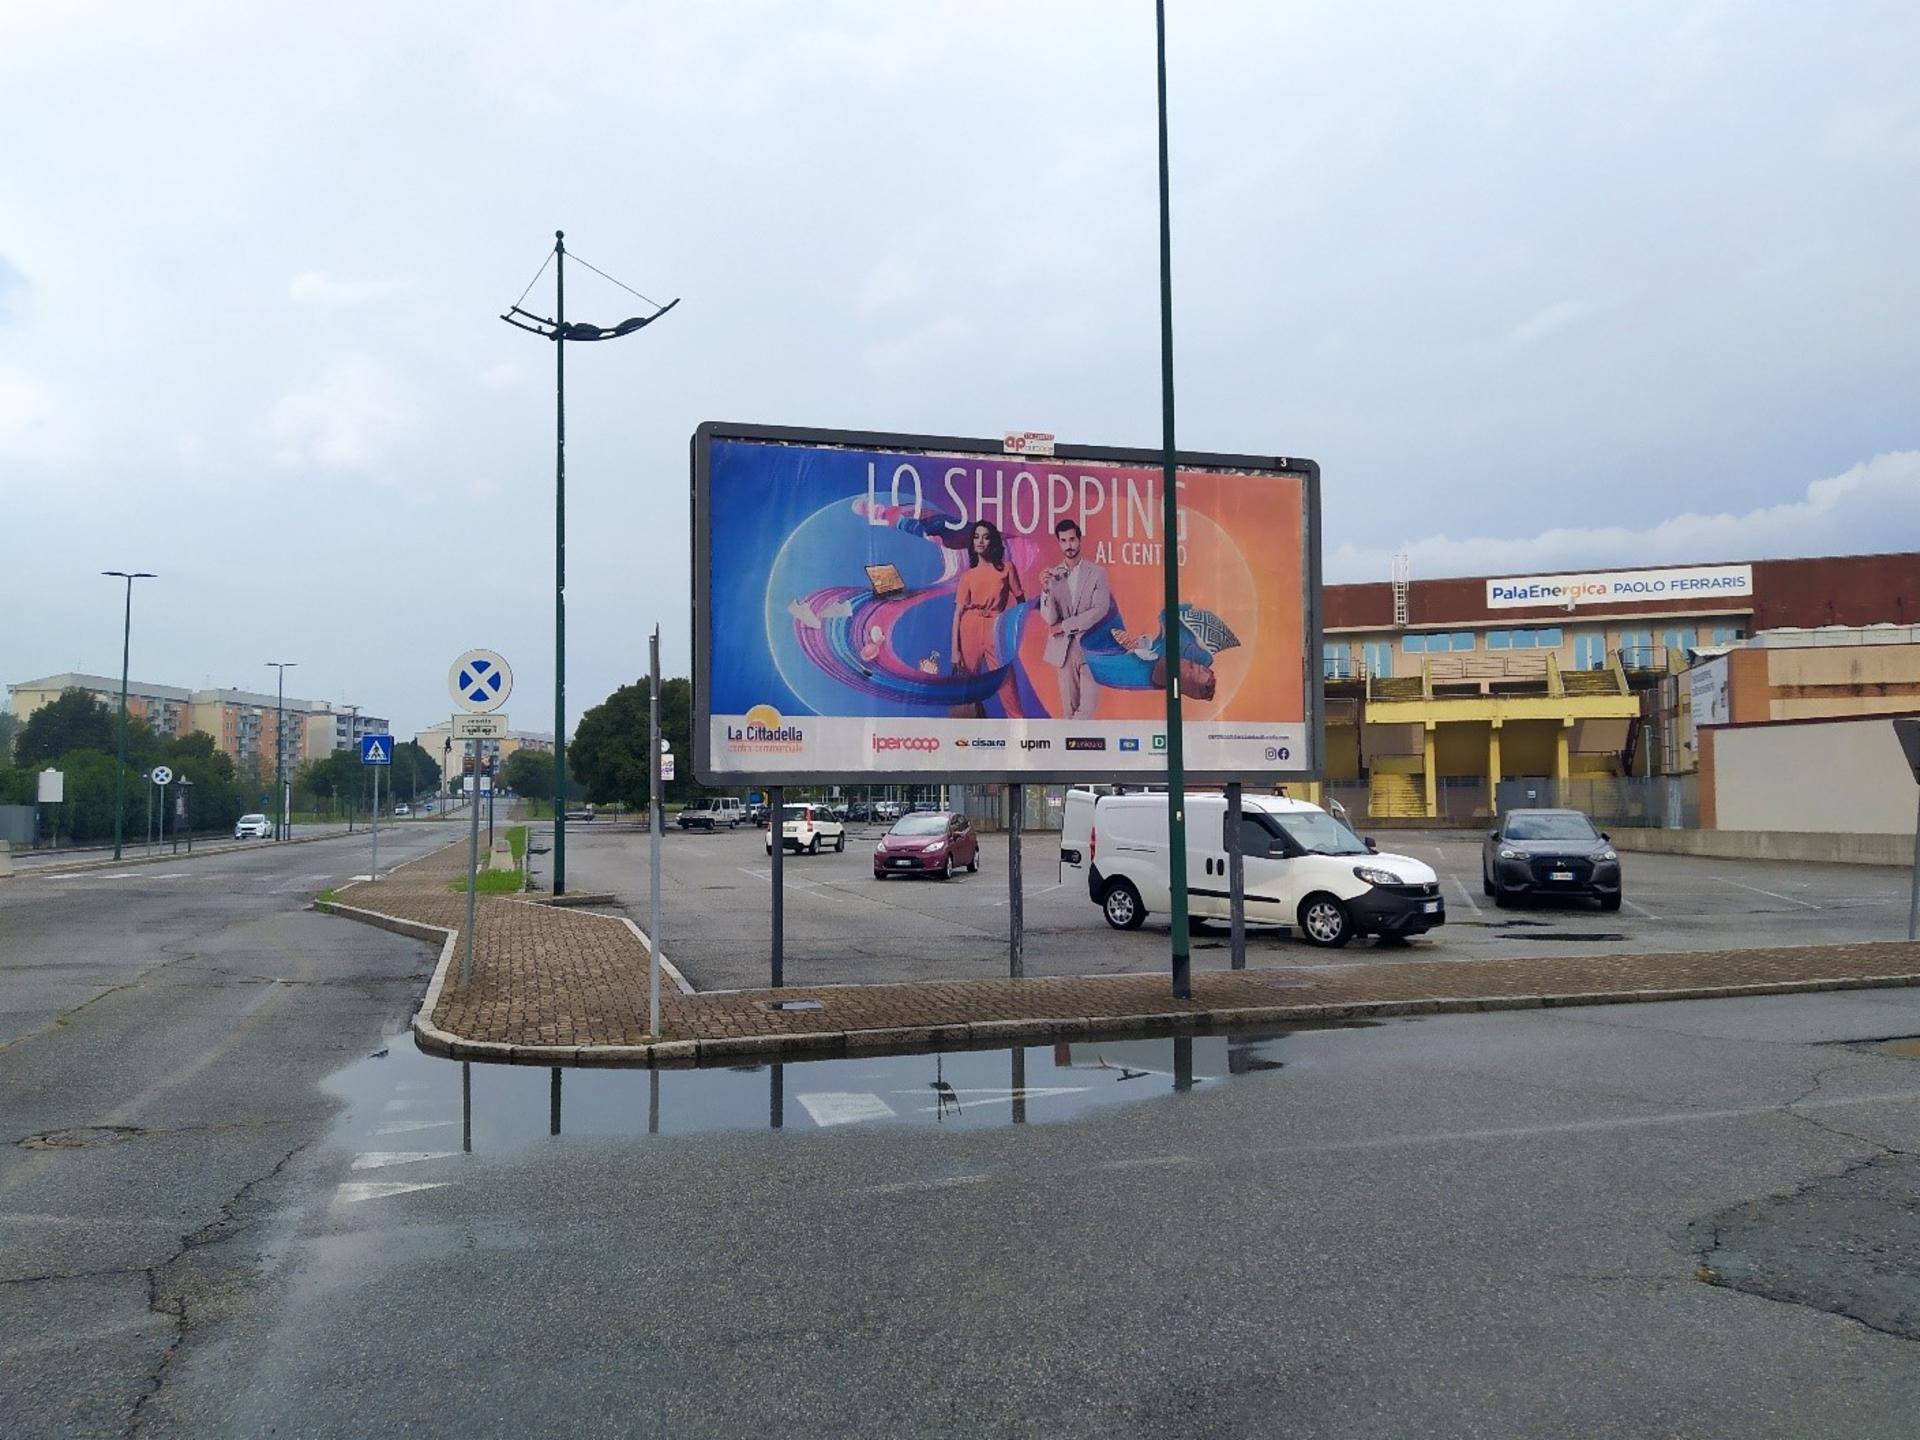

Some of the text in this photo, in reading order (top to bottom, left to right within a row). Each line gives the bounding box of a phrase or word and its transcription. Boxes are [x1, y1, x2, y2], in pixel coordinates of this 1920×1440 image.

[867, 462, 923, 526] LO
[1095, 540, 1187, 567] AL CENTO
[1492, 576, 1747, 600] PalaEnergica PAOLO FERRARIS
[727, 726, 803, 741] La Cittadella
[872, 733, 940, 753] ipercoop
[1020, 739, 1051, 751] upim
